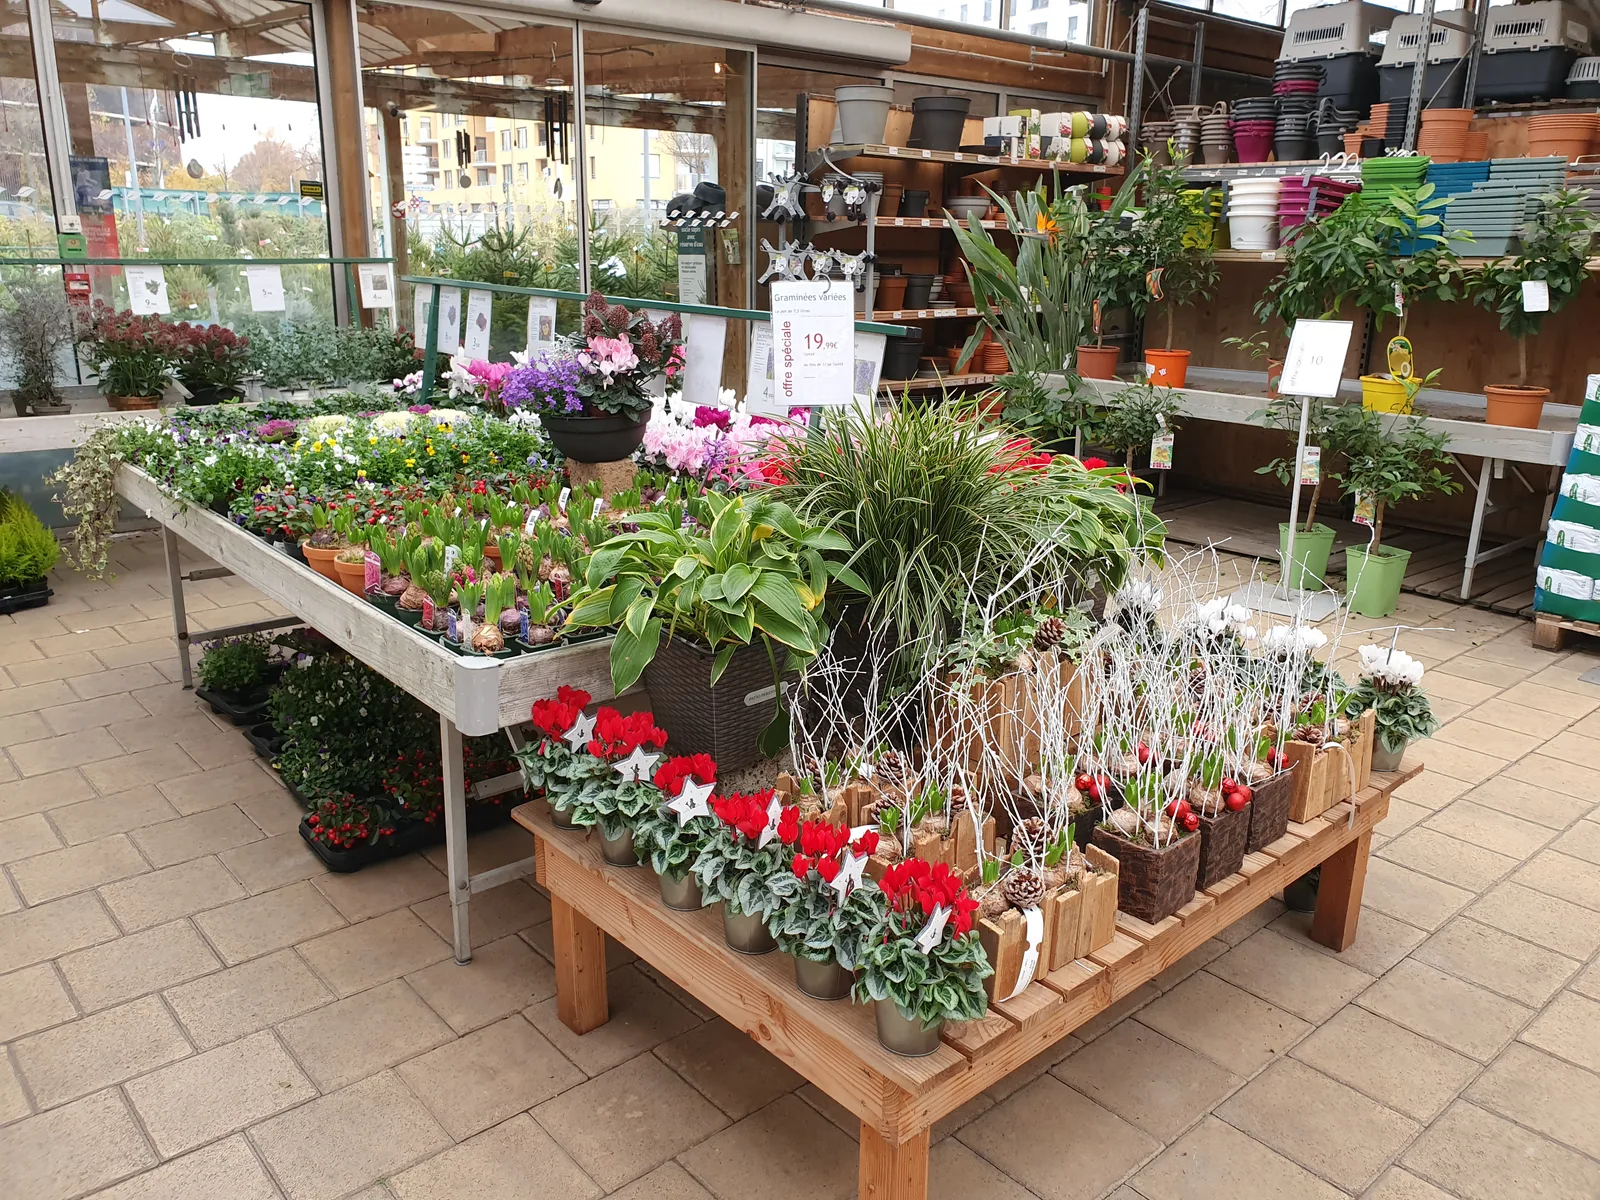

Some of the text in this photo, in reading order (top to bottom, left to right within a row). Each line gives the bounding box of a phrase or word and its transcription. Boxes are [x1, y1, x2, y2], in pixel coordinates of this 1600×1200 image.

[774, 292, 847, 302] Graminées variées
[804, 332, 839, 350] 19,99€
[781, 320, 794, 397] offre spéciale
[1310, 355, 1324, 366] 10
